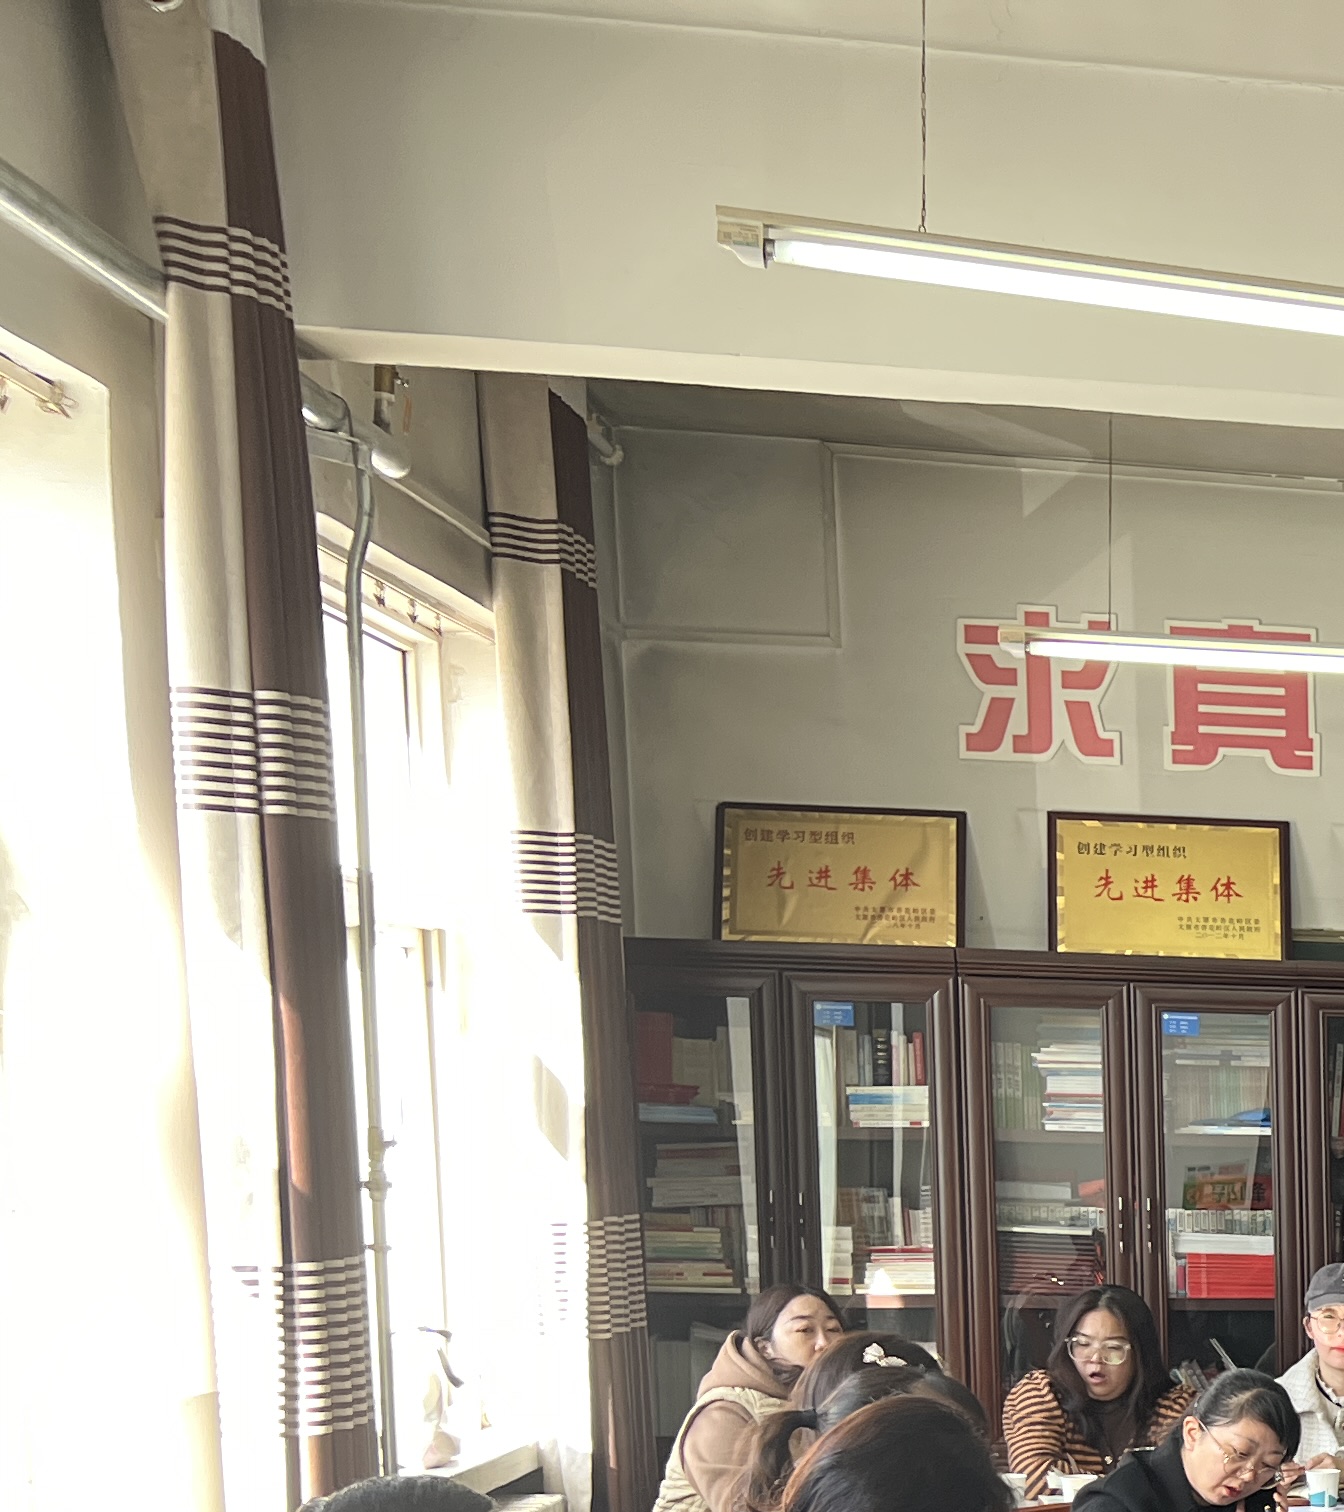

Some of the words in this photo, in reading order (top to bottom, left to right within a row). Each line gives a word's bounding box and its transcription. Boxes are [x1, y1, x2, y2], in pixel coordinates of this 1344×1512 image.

[744, 828, 855, 845] 创建学习型组织
[1077, 841, 1187, 859] 创建学习型组织
[766, 860, 920, 892] 先进集体
[1094, 869, 1244, 904] 先进集体
